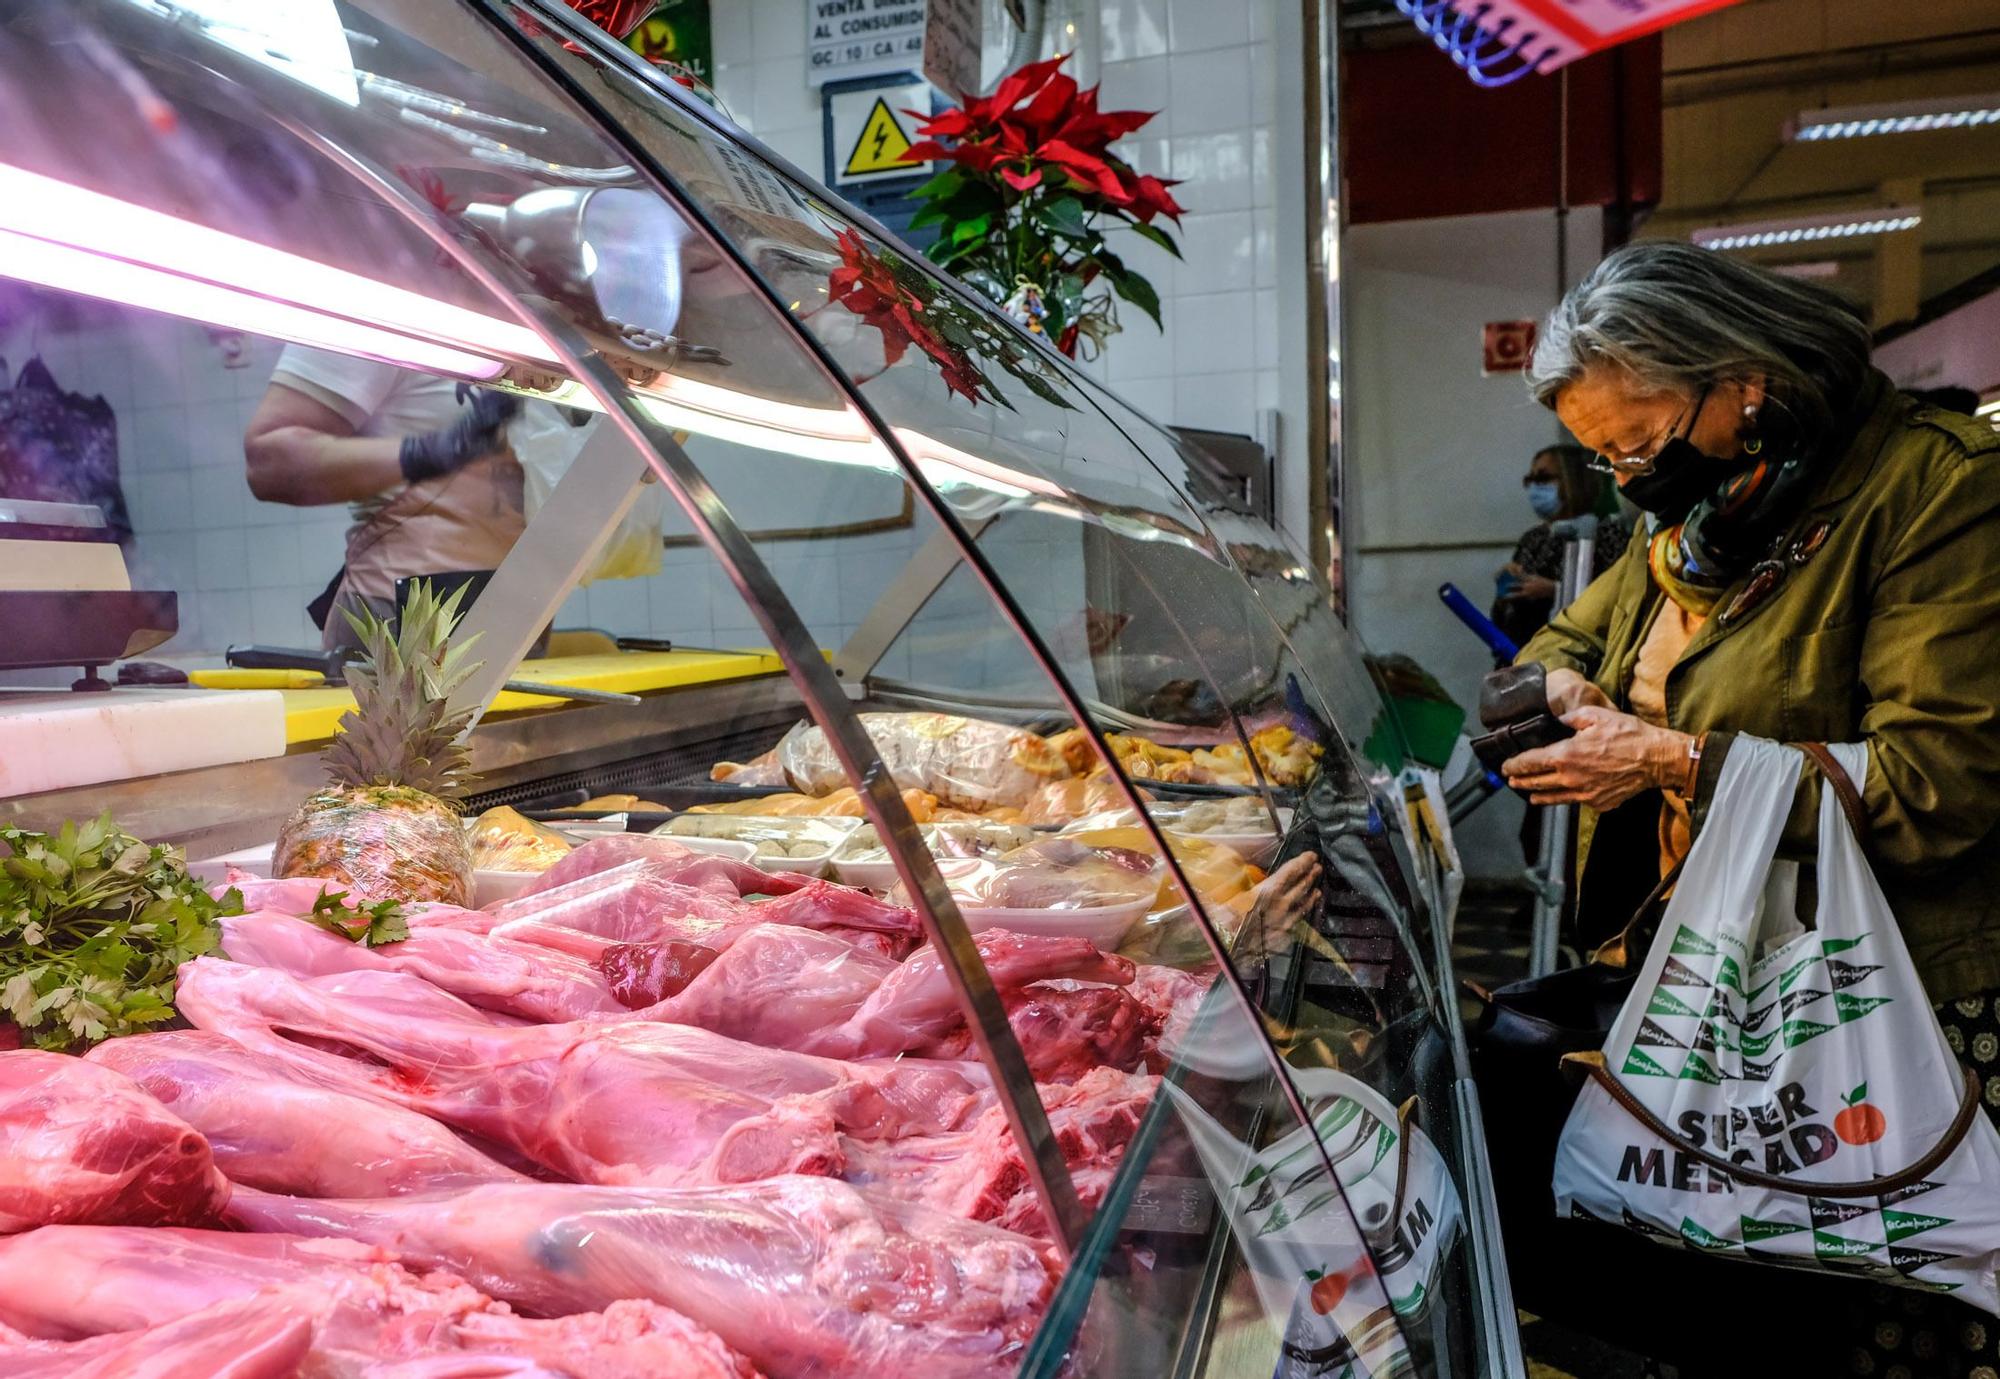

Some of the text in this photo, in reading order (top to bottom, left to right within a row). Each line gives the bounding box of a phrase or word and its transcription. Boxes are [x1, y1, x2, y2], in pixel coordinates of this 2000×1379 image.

[817, 0, 864, 18] VENTA
[814, 24, 832, 39] AL
[812, 51, 832, 65] GC
[873, 41, 893, 56] CA
